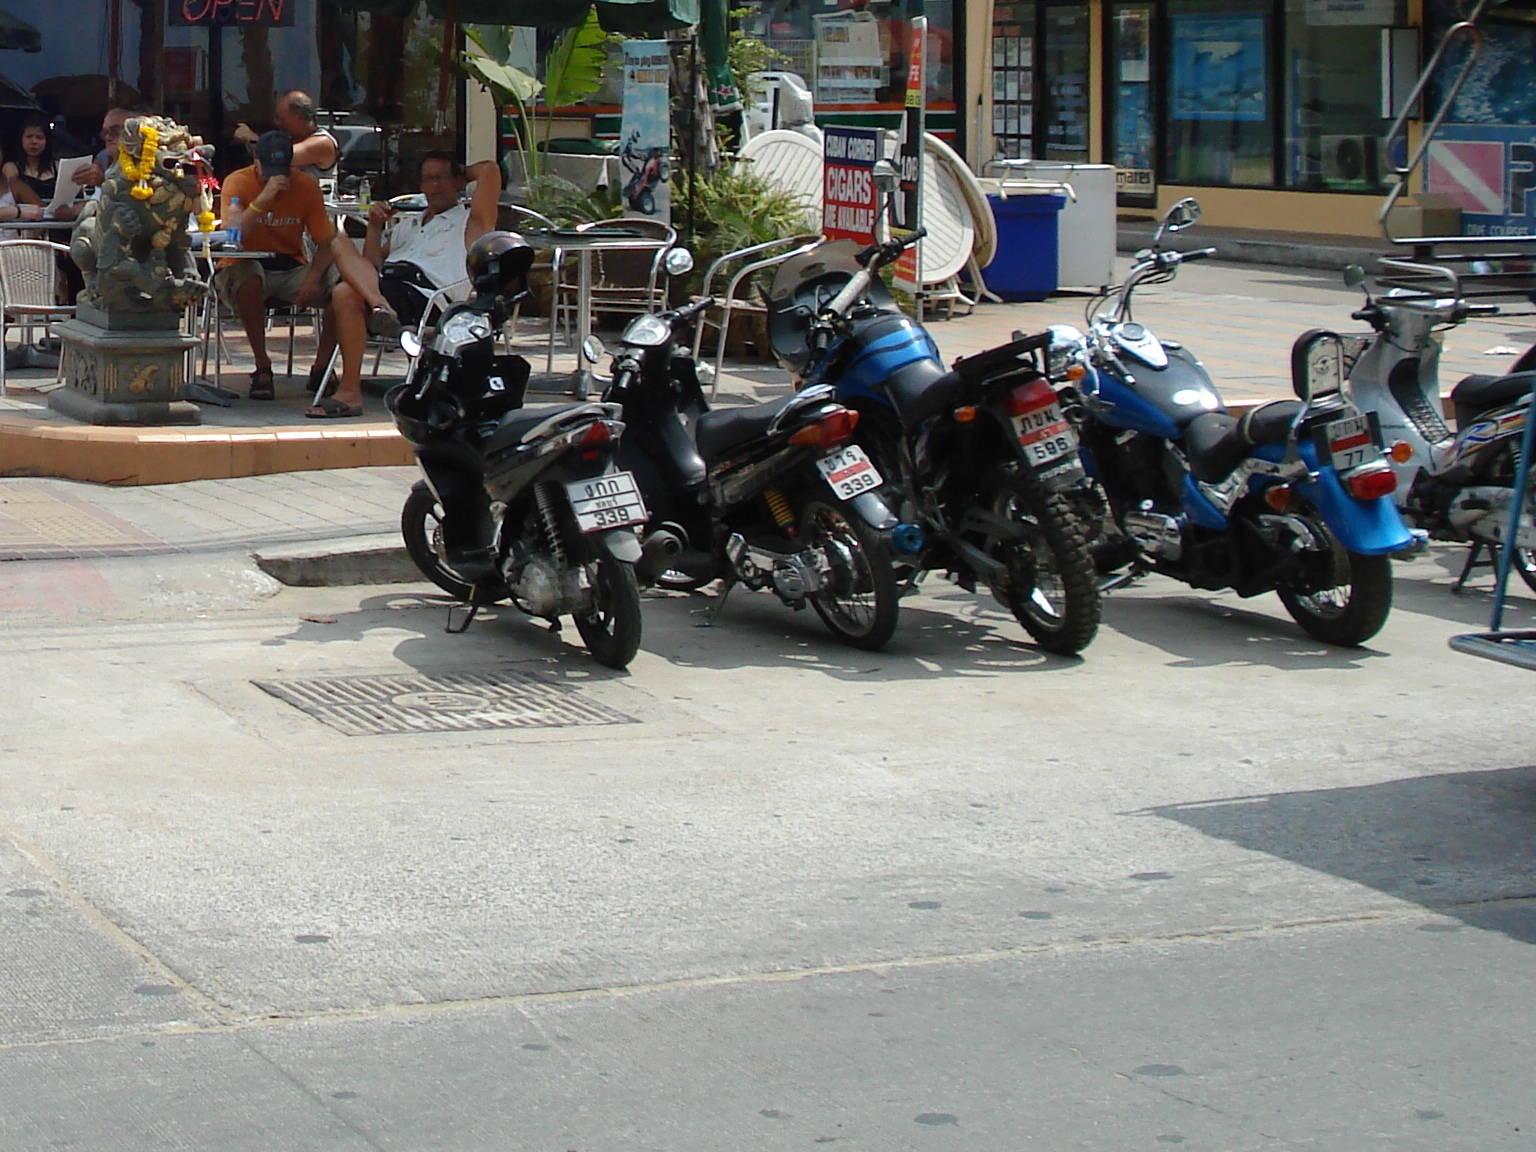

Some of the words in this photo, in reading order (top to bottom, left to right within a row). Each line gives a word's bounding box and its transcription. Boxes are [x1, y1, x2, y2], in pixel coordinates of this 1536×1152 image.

[827, 167, 872, 205] CIGARS
[1343, 448, 1365, 467] 77
[840, 473, 875, 496] 339
[594, 508, 630, 527] 339
